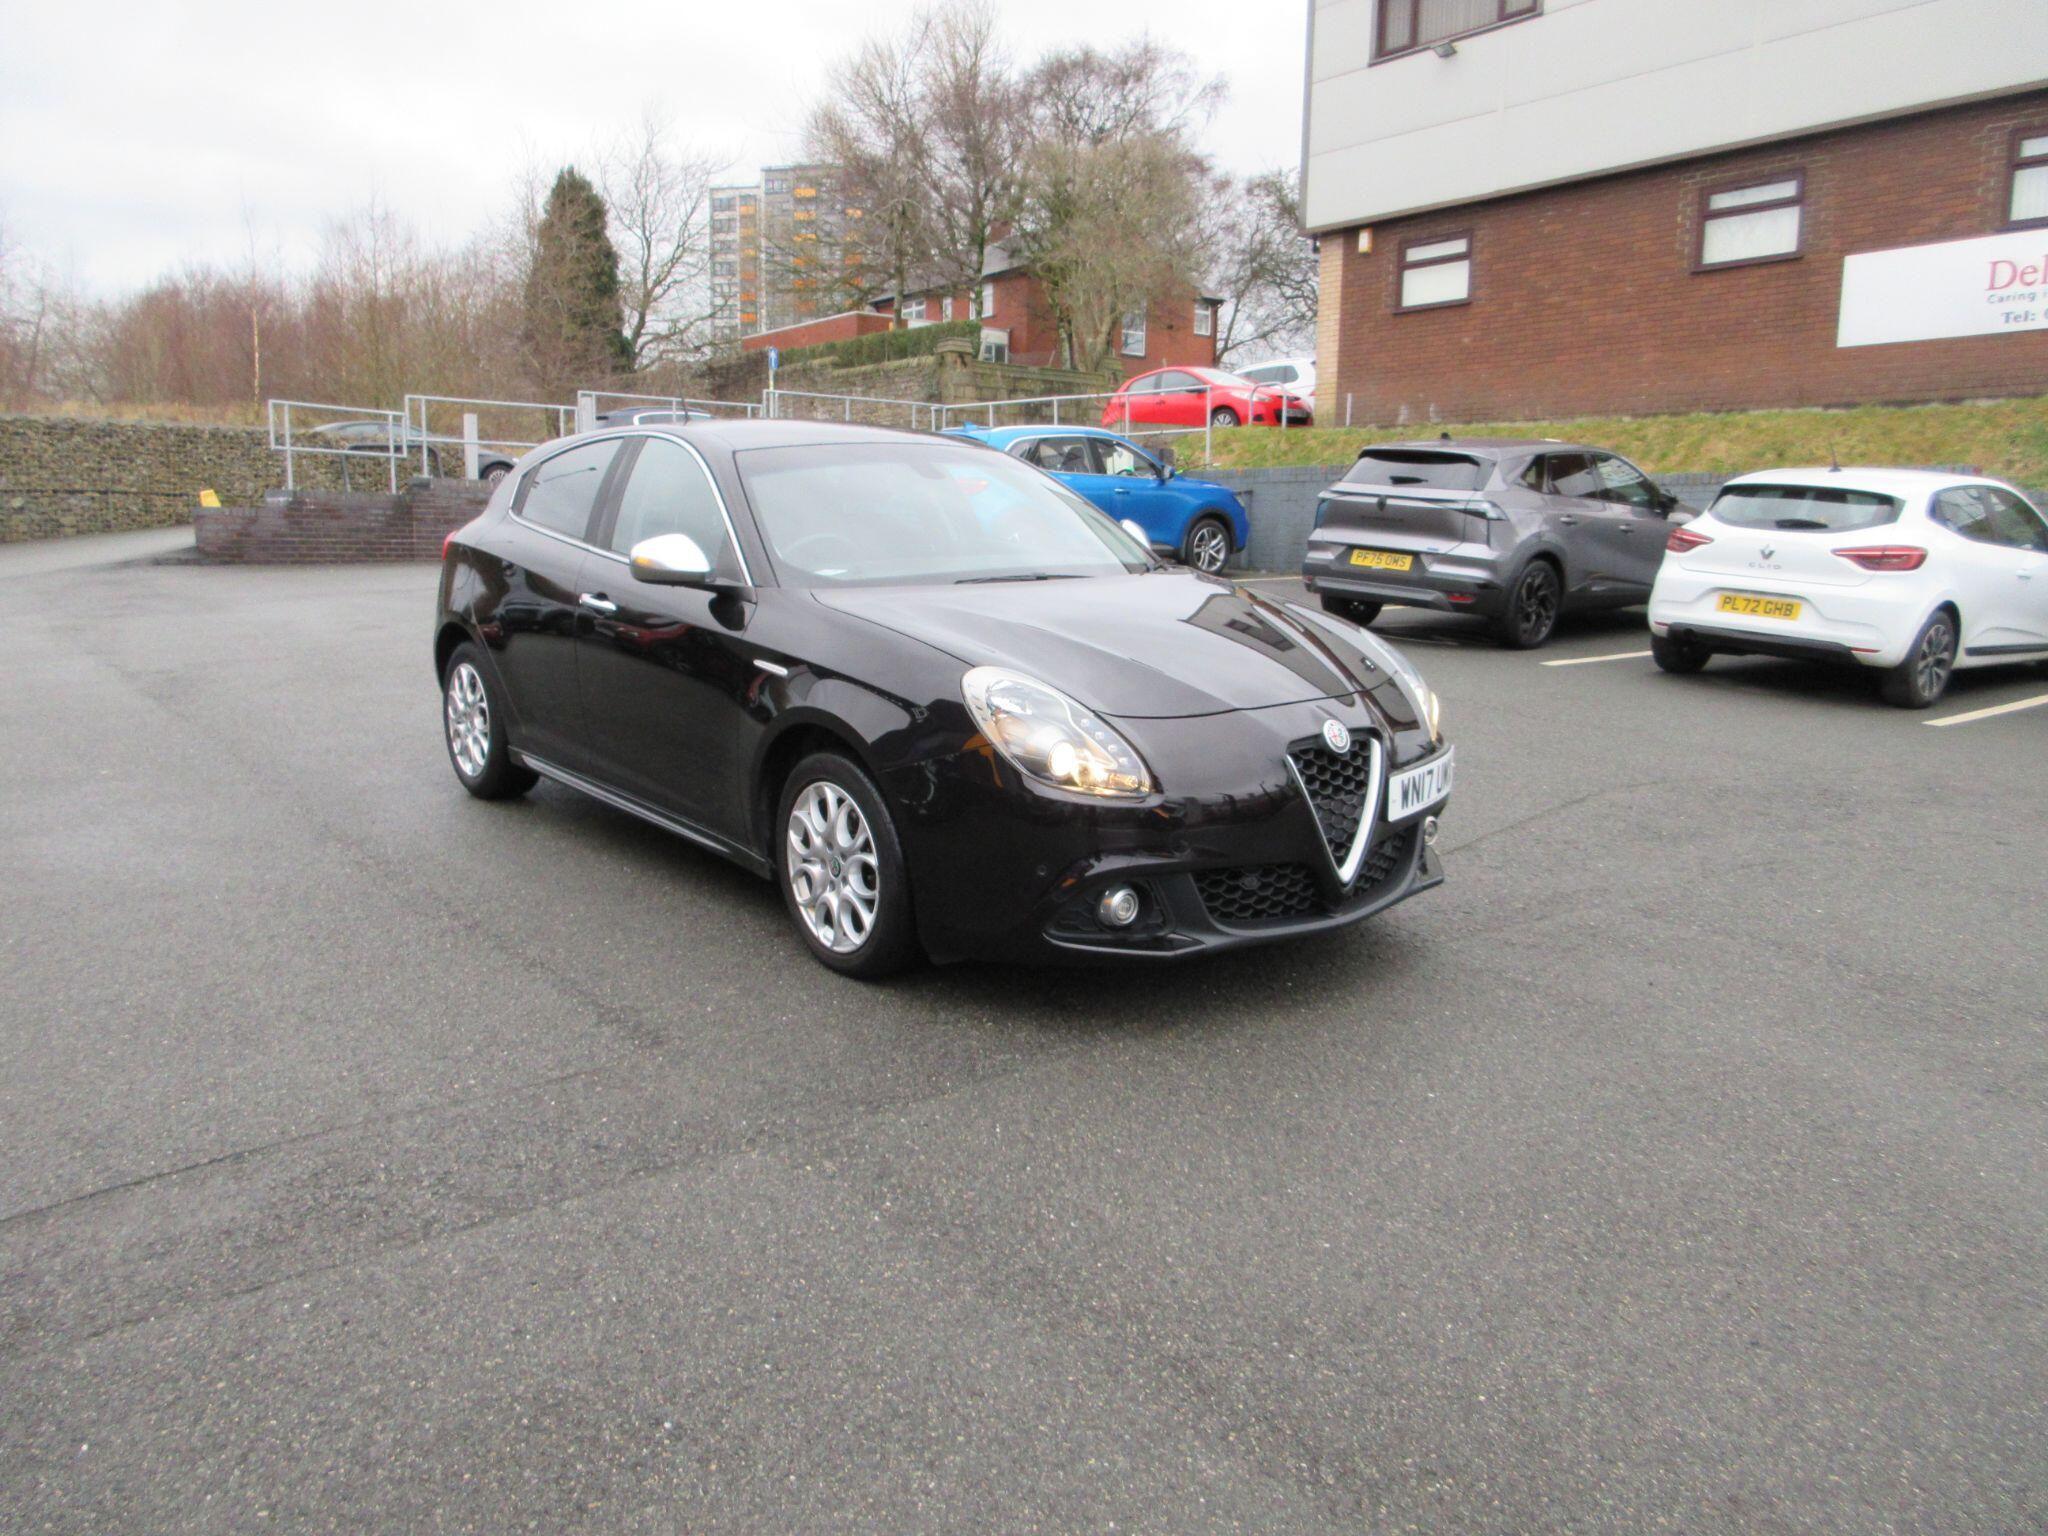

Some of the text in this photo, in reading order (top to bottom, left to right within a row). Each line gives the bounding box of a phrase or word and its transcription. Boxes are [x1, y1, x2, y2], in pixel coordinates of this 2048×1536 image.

[1987, 291, 2036, 304] Caring
[2001, 310, 2037, 324] Tel:
[1721, 596, 1794, 617] PL72 GHB
[1401, 768, 1434, 810] WN17
